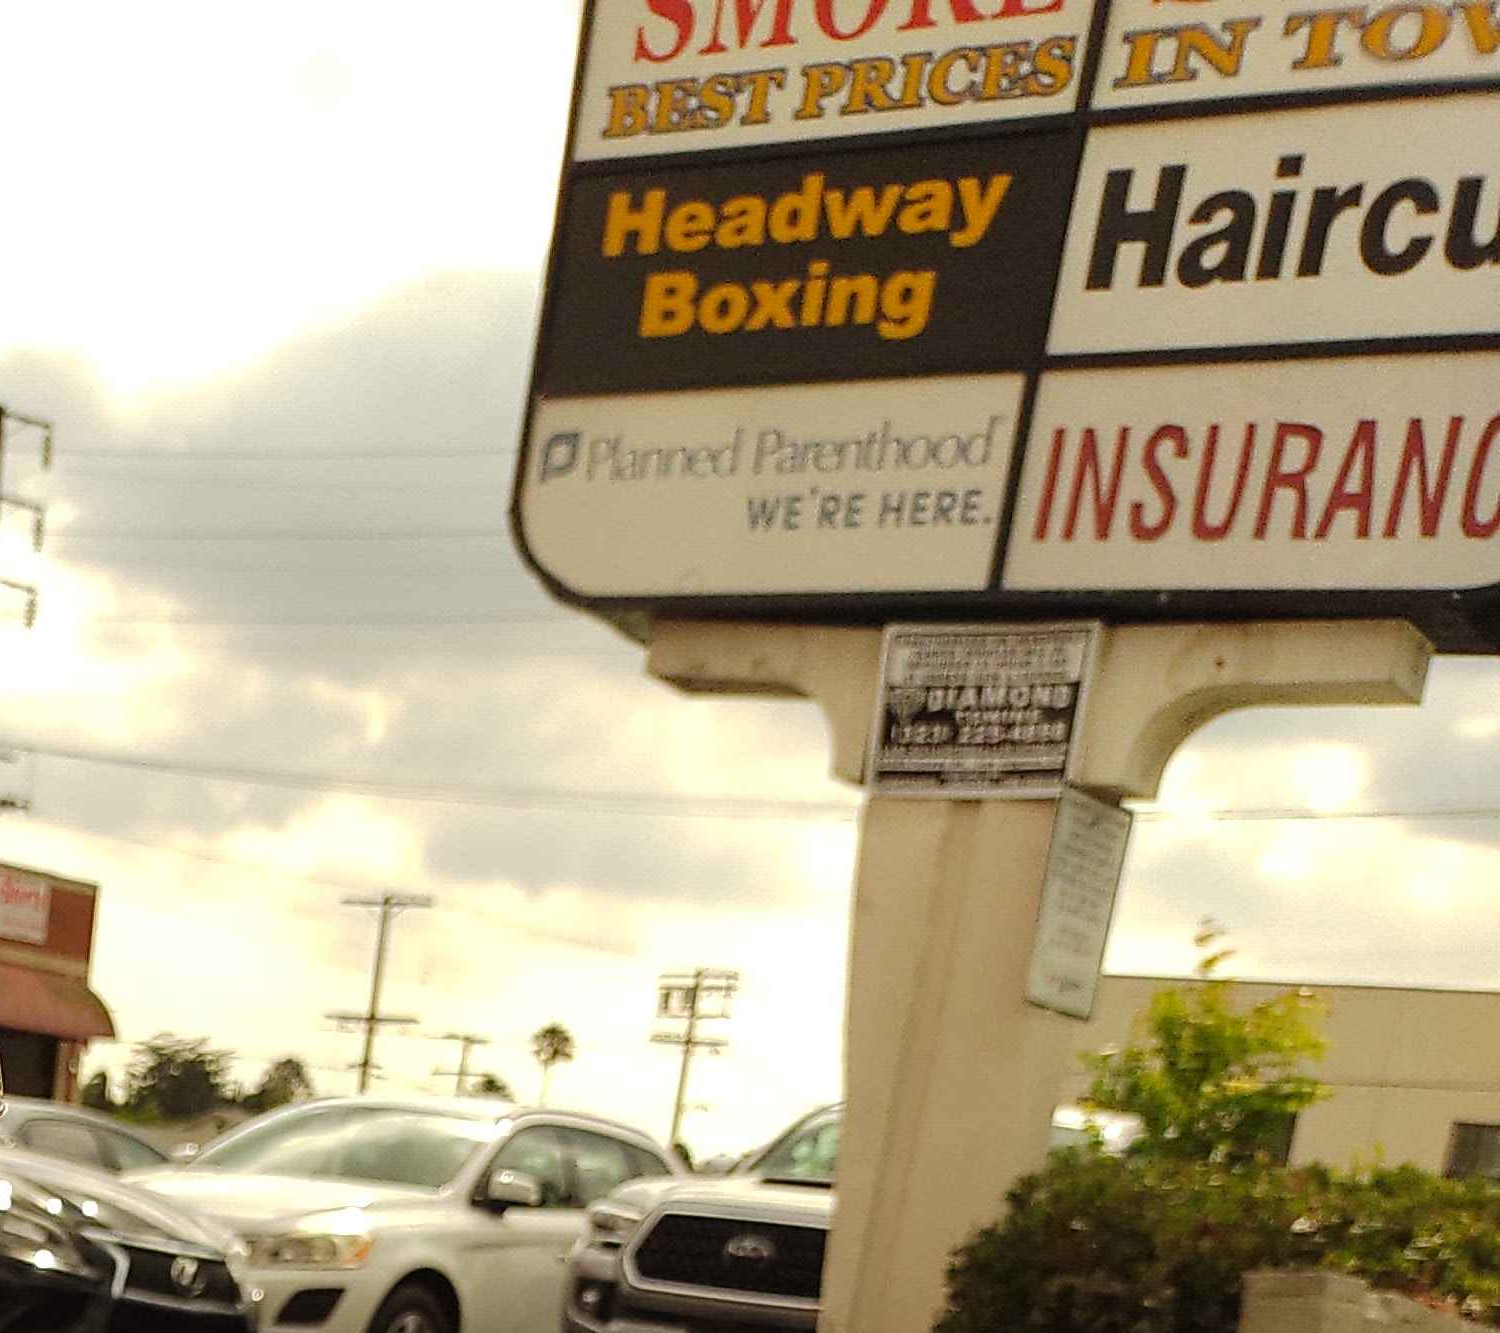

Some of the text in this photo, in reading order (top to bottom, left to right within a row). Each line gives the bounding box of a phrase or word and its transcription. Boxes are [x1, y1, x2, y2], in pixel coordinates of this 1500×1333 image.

[601, 35, 1077, 139] BEST PRICES
[1113, 15, 1263, 89] IN
[602, 168, 1013, 257] Headway
[638, 259, 937, 341] Boxing
[586, 415, 1003, 482] Planned Parenthood
[746, 487, 994, 532] WE'RE HERE.
[927, 685, 1073, 713] DIAMOND
